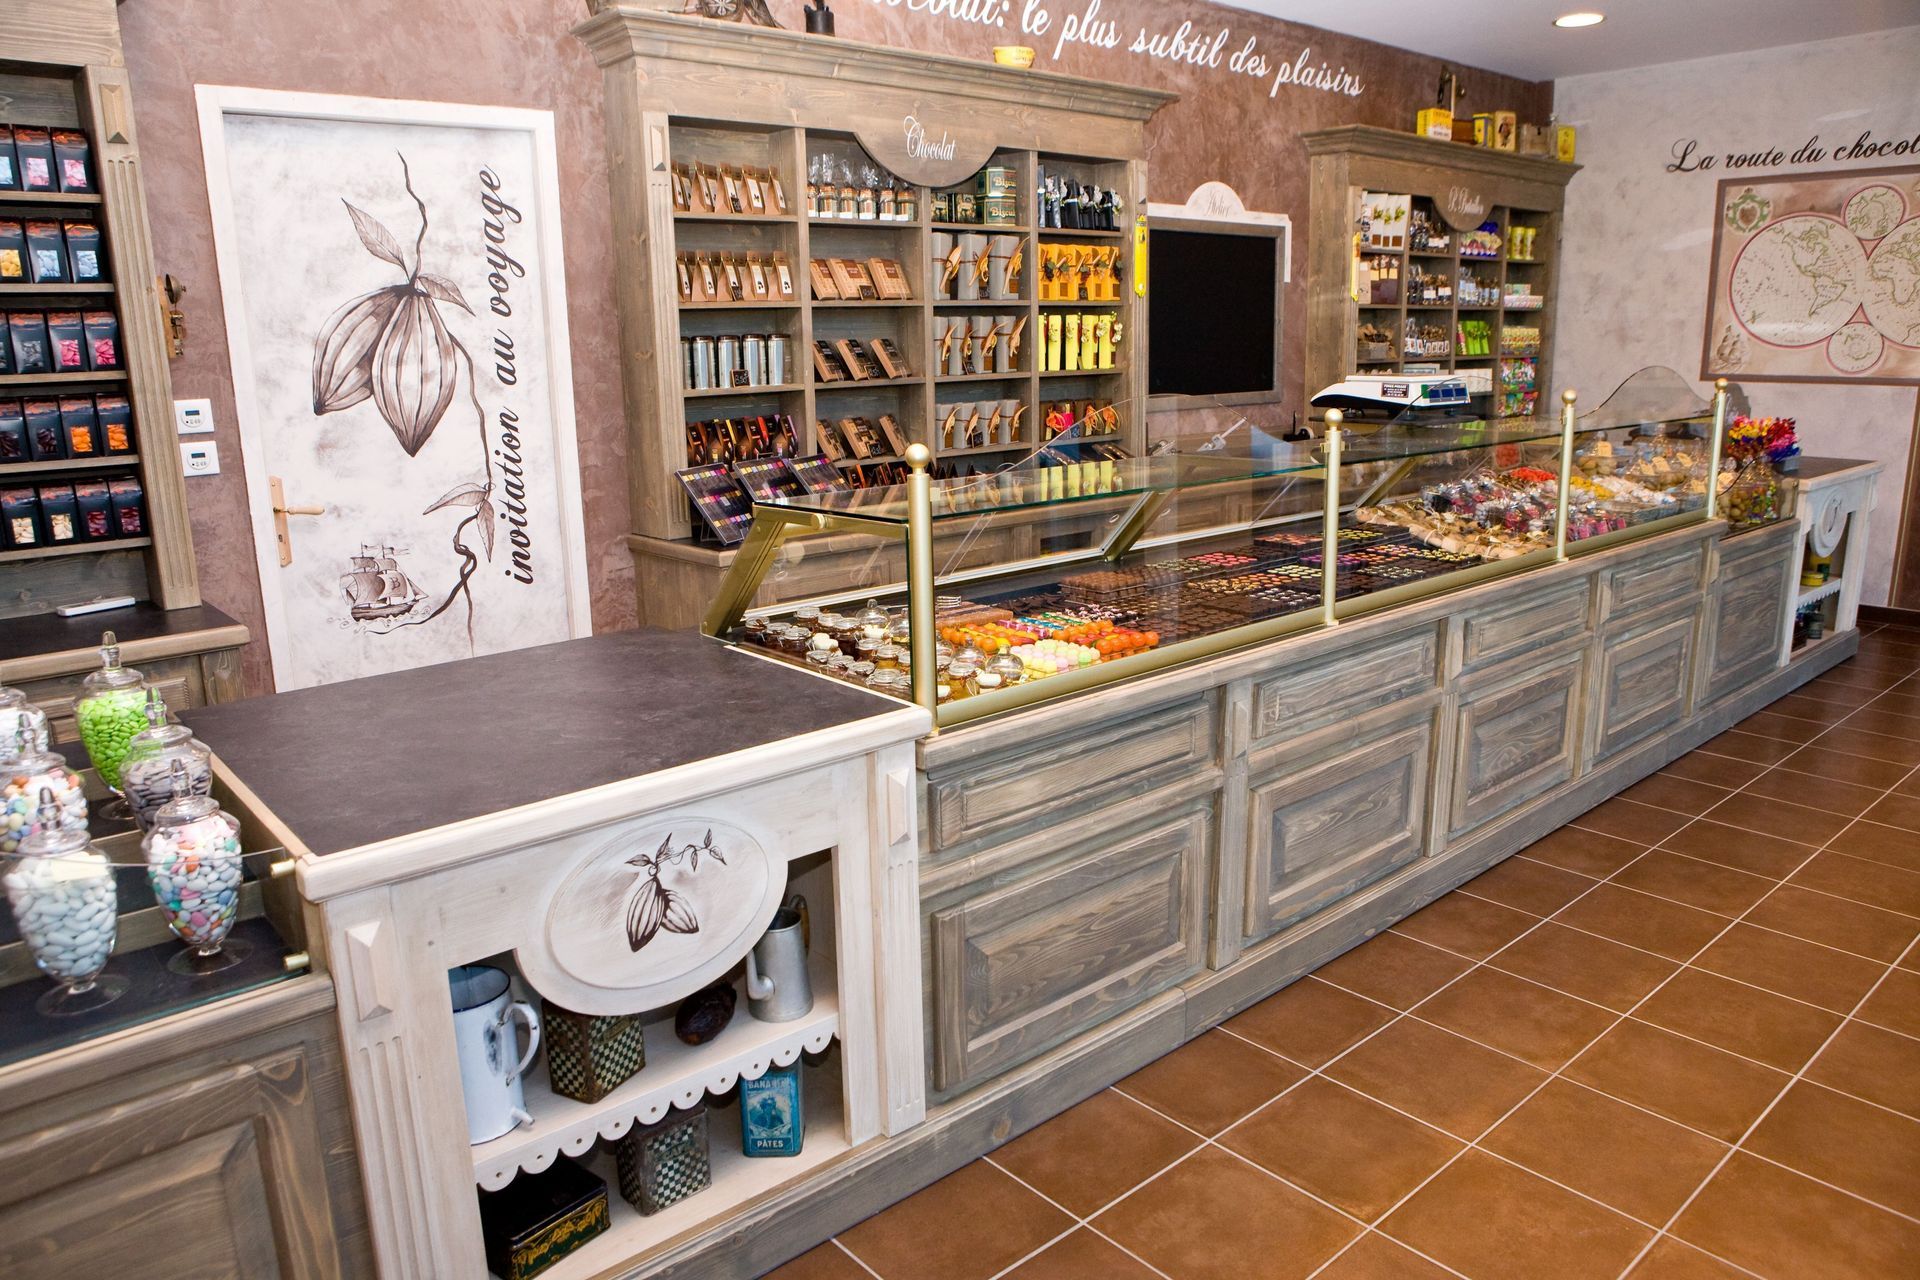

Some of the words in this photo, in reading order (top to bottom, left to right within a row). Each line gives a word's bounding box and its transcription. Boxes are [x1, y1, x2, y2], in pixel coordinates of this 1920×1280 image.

[1022, 0, 1052, 35] le
[1052, 0, 1122, 60] plus
[1128, 20, 1230, 68] subtil
[1229, 35, 1272, 77] des
[1269, 47, 1366, 98] plaisirs
[903, 115, 956, 161] Chocolat
[1666, 138, 1719, 173] La
[1725, 145, 1785, 169] route
[1790, 135, 1828, 164] du
[479, 163, 526, 318] voyage
[494, 327, 518, 386] au
[495, 405, 534, 585] invitation
[756, 1139, 784, 1148] PÂTES
